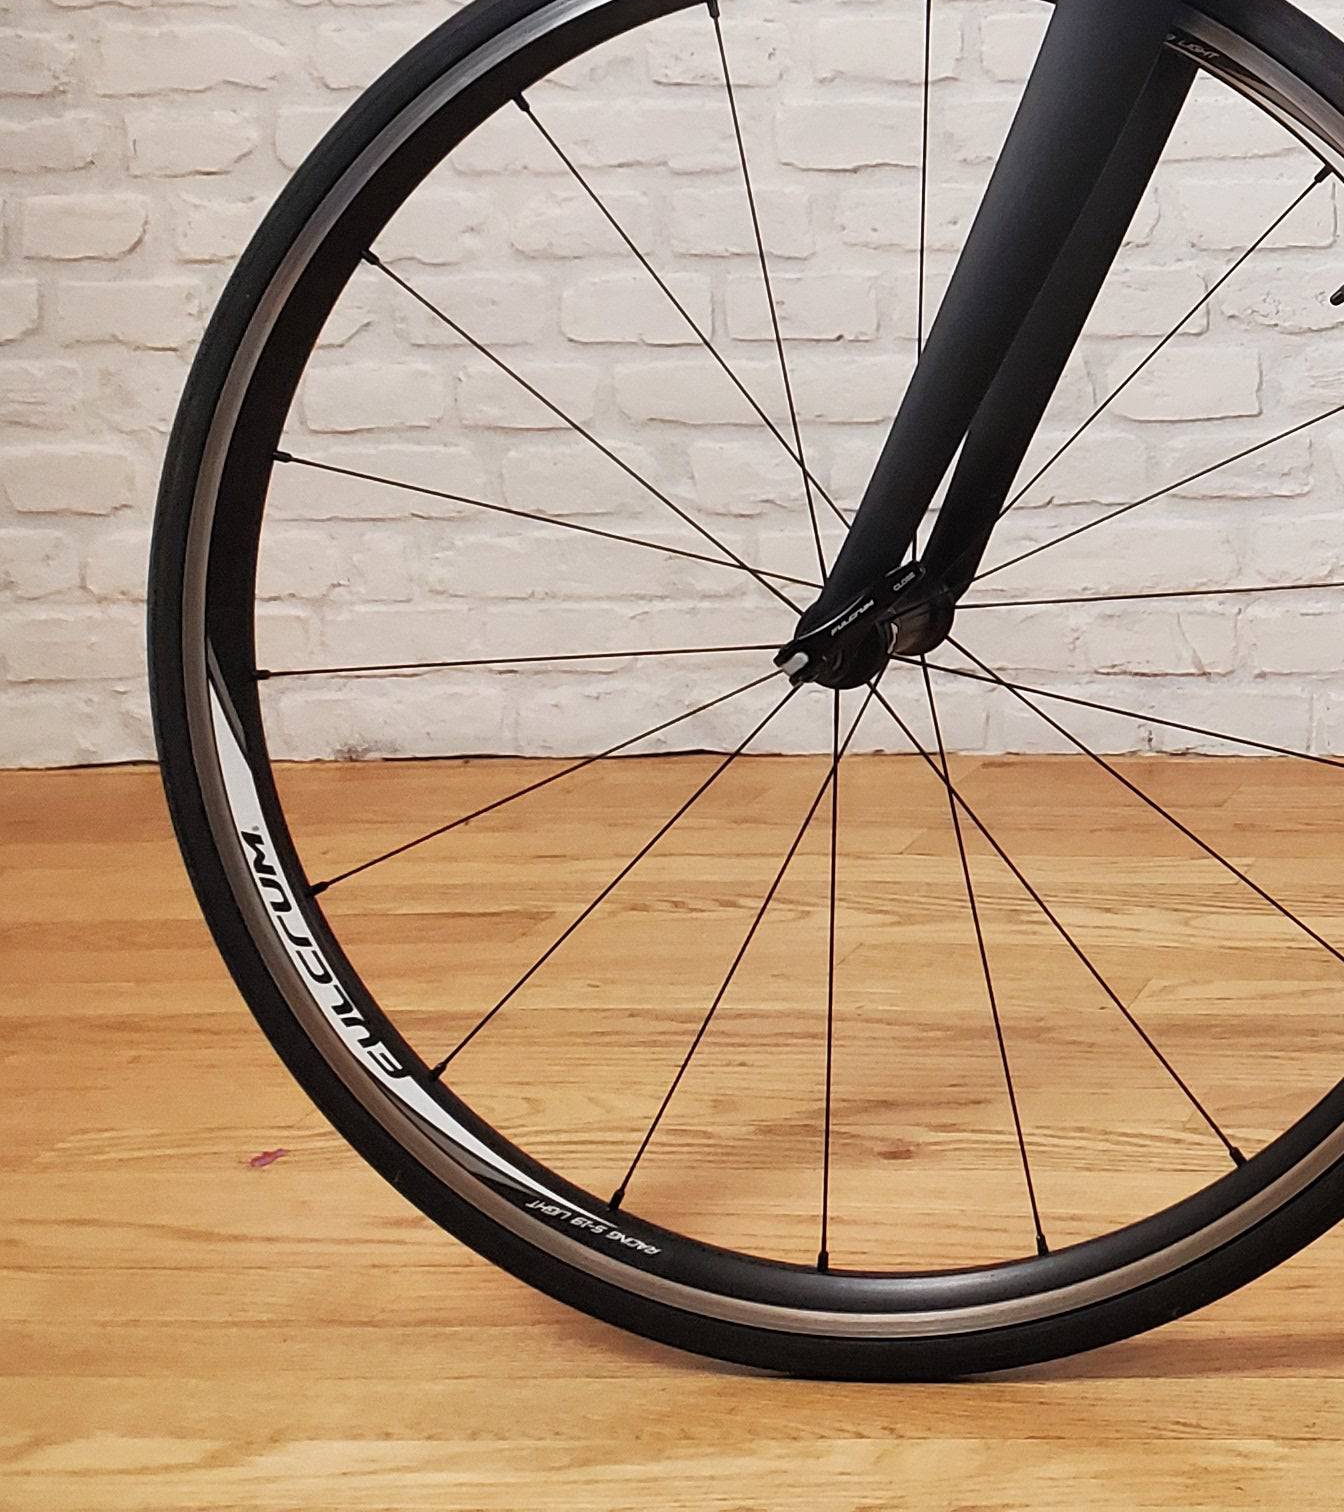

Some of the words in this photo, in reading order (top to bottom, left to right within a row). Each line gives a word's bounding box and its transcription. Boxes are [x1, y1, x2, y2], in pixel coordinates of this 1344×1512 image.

[241, 830, 411, 1080] FULCRUM
[525, 1200, 572, 1220] LIGHT
[606, 1231, 662, 1255] RACING
